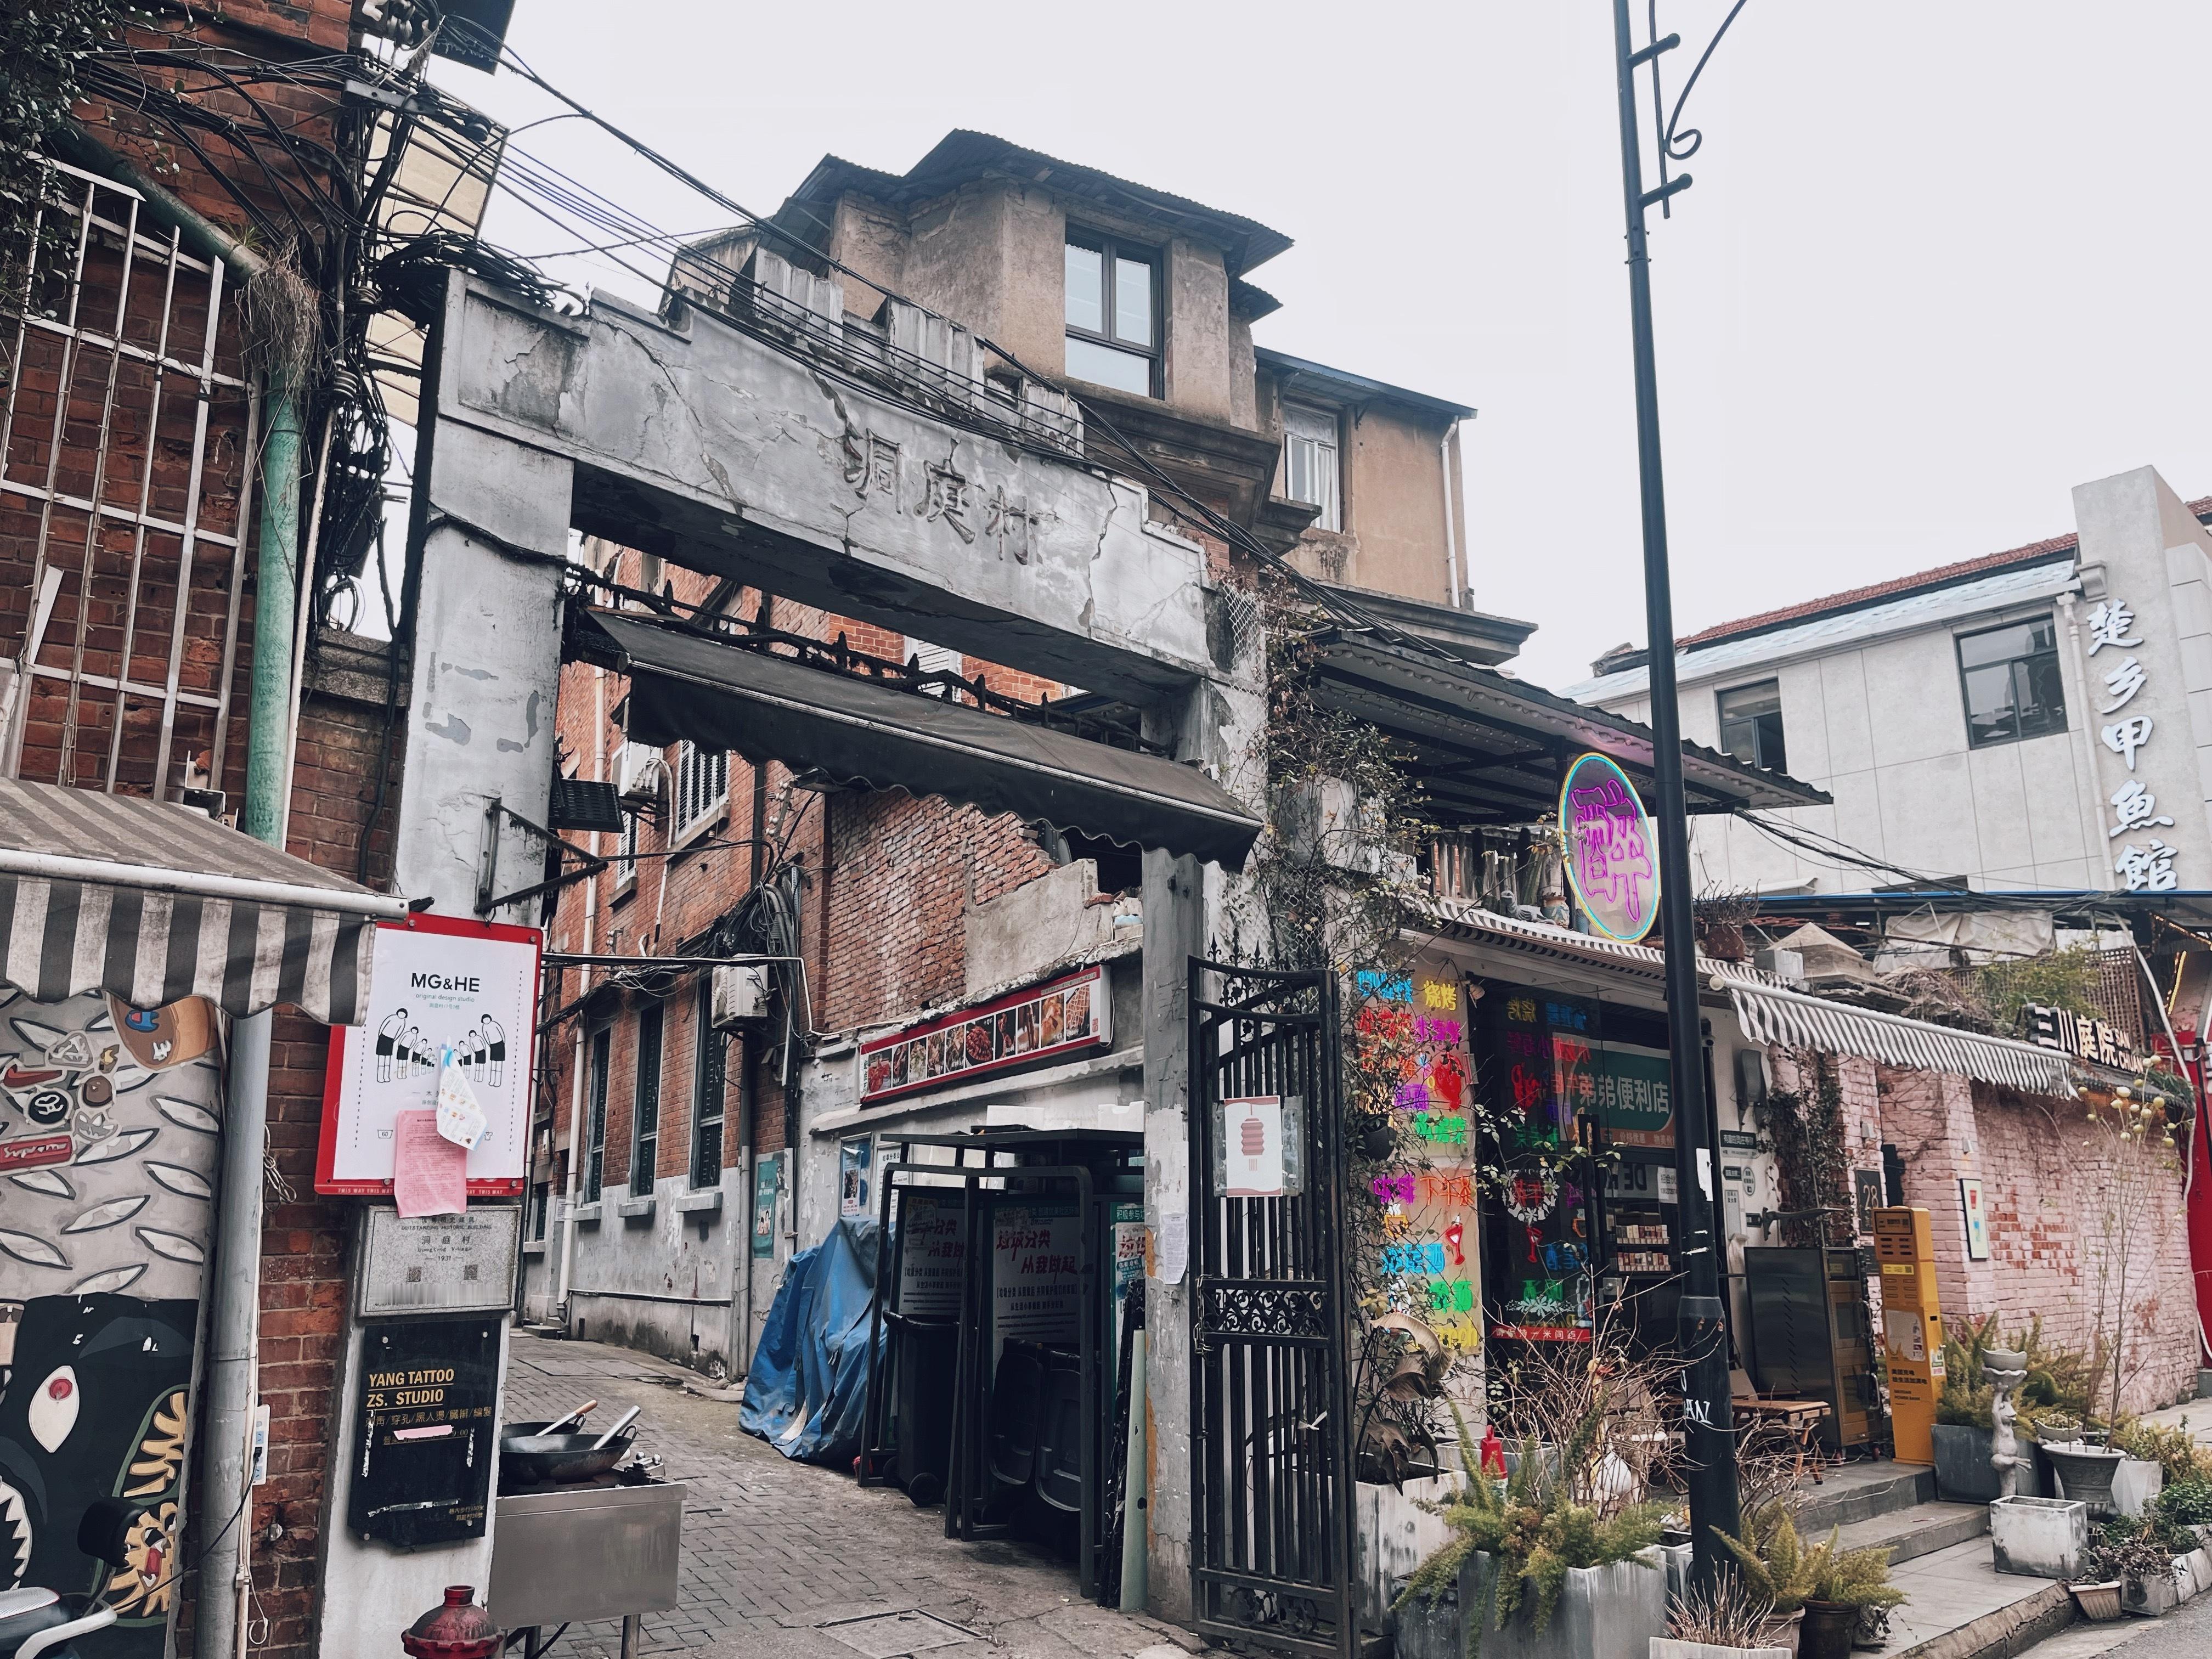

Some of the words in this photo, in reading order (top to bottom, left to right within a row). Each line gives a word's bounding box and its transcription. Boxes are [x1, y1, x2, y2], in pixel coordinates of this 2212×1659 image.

[843, 428, 1039, 565] 洞庭村
[411, 973, 480, 992] MG&HE
[1424, 979, 1457, 1011] 烧烤
[2115, 1028, 2131, 1051] SAN
[2118, 1052, 2144, 1074] CHUAN
[1578, 1073, 1670, 1114] 弟弟便利店
[1654, 1134, 1675, 1146] 物美价
[1863, 1184, 1879, 1211] 28
[421, 1235, 470, 1245] 洞庭村
[1020, 1254, 1078, 1284] 从我做起
[368, 1372, 405, 1387] YANG
[408, 1368, 455, 1384] TATTOO
[366, 1393, 388, 1408] ZS.
[396, 1389, 444, 1406] STUDIO
